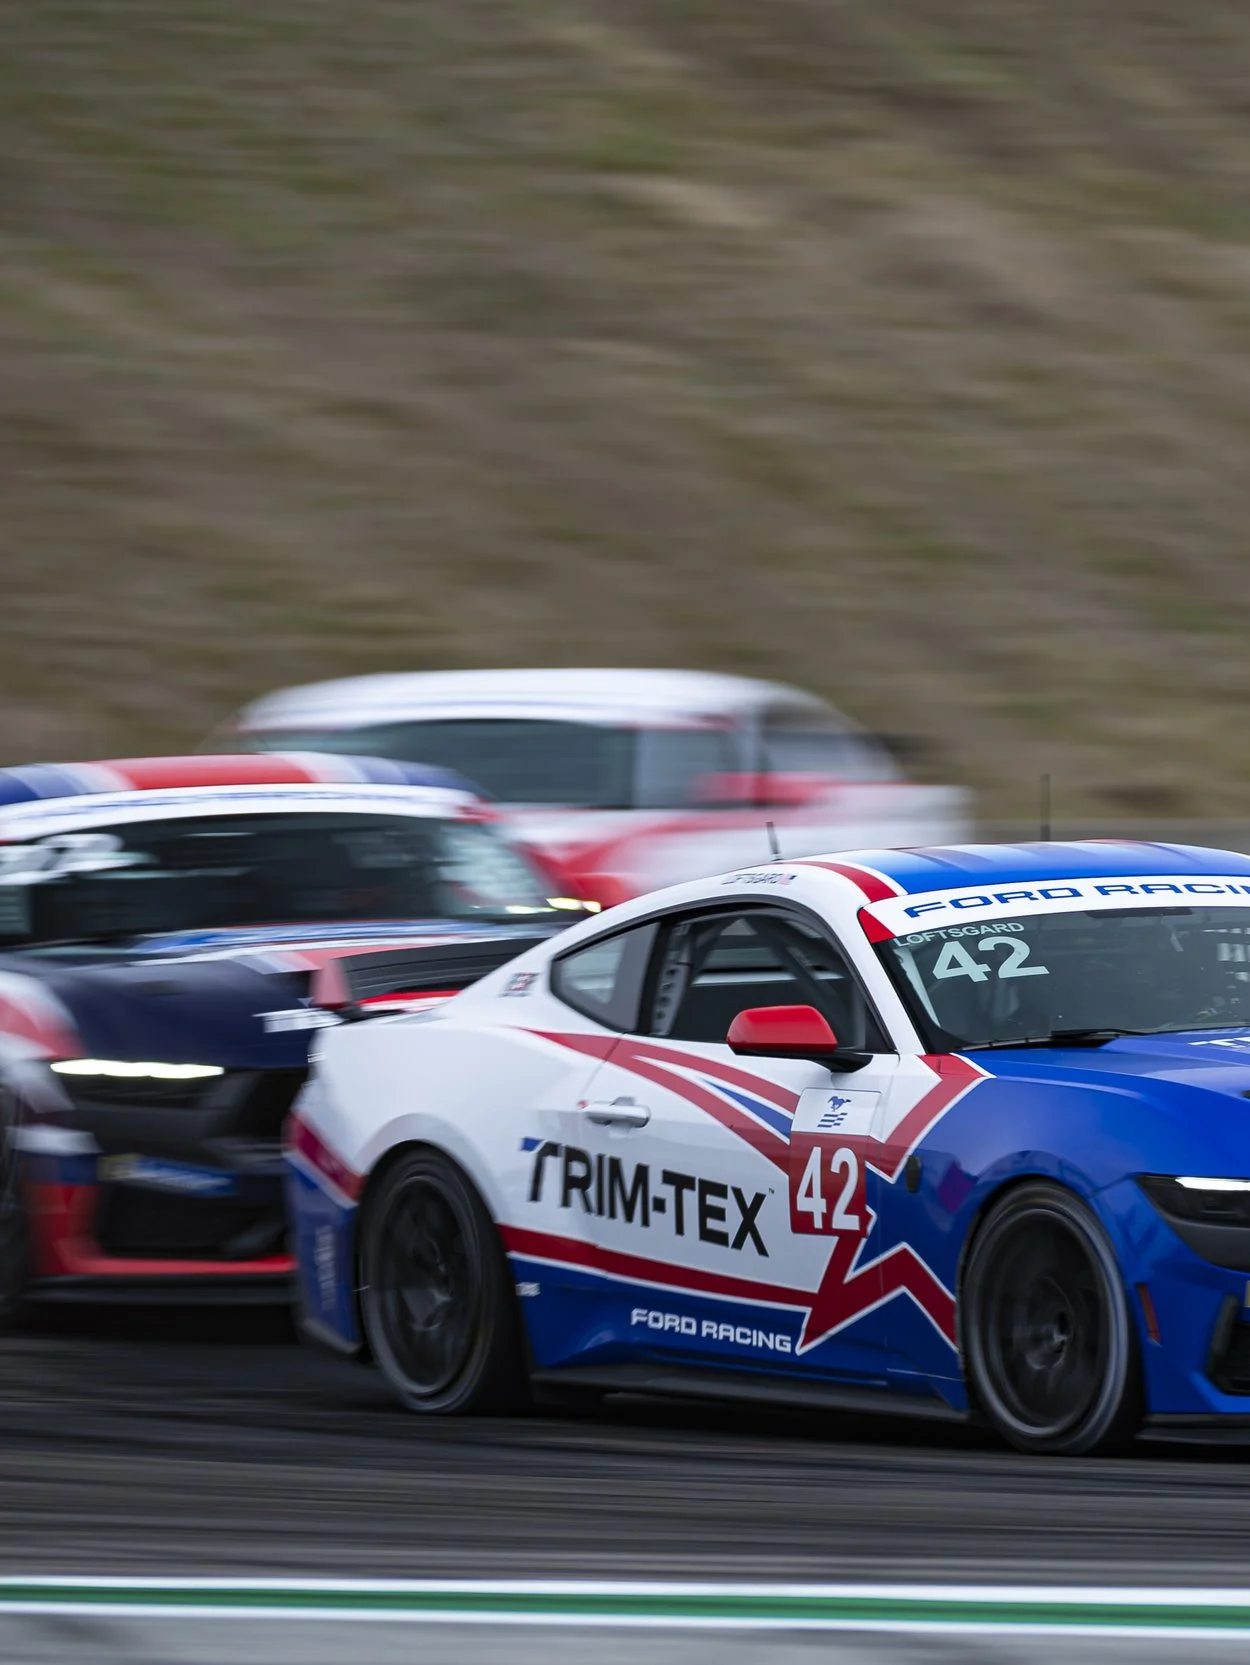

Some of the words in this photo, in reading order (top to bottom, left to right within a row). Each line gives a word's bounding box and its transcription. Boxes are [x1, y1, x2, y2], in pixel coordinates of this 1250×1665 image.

[903, 886, 1084, 918] FORD
[892, 922, 1025, 947] LOFTSGARD
[932, 935, 1050, 983] 42
[521, 1137, 769, 1257] TRIM-TEX
[796, 1146, 860, 1231] 42
[631, 1307, 697, 1335] FORD
[701, 1320, 792, 1353] RACING
